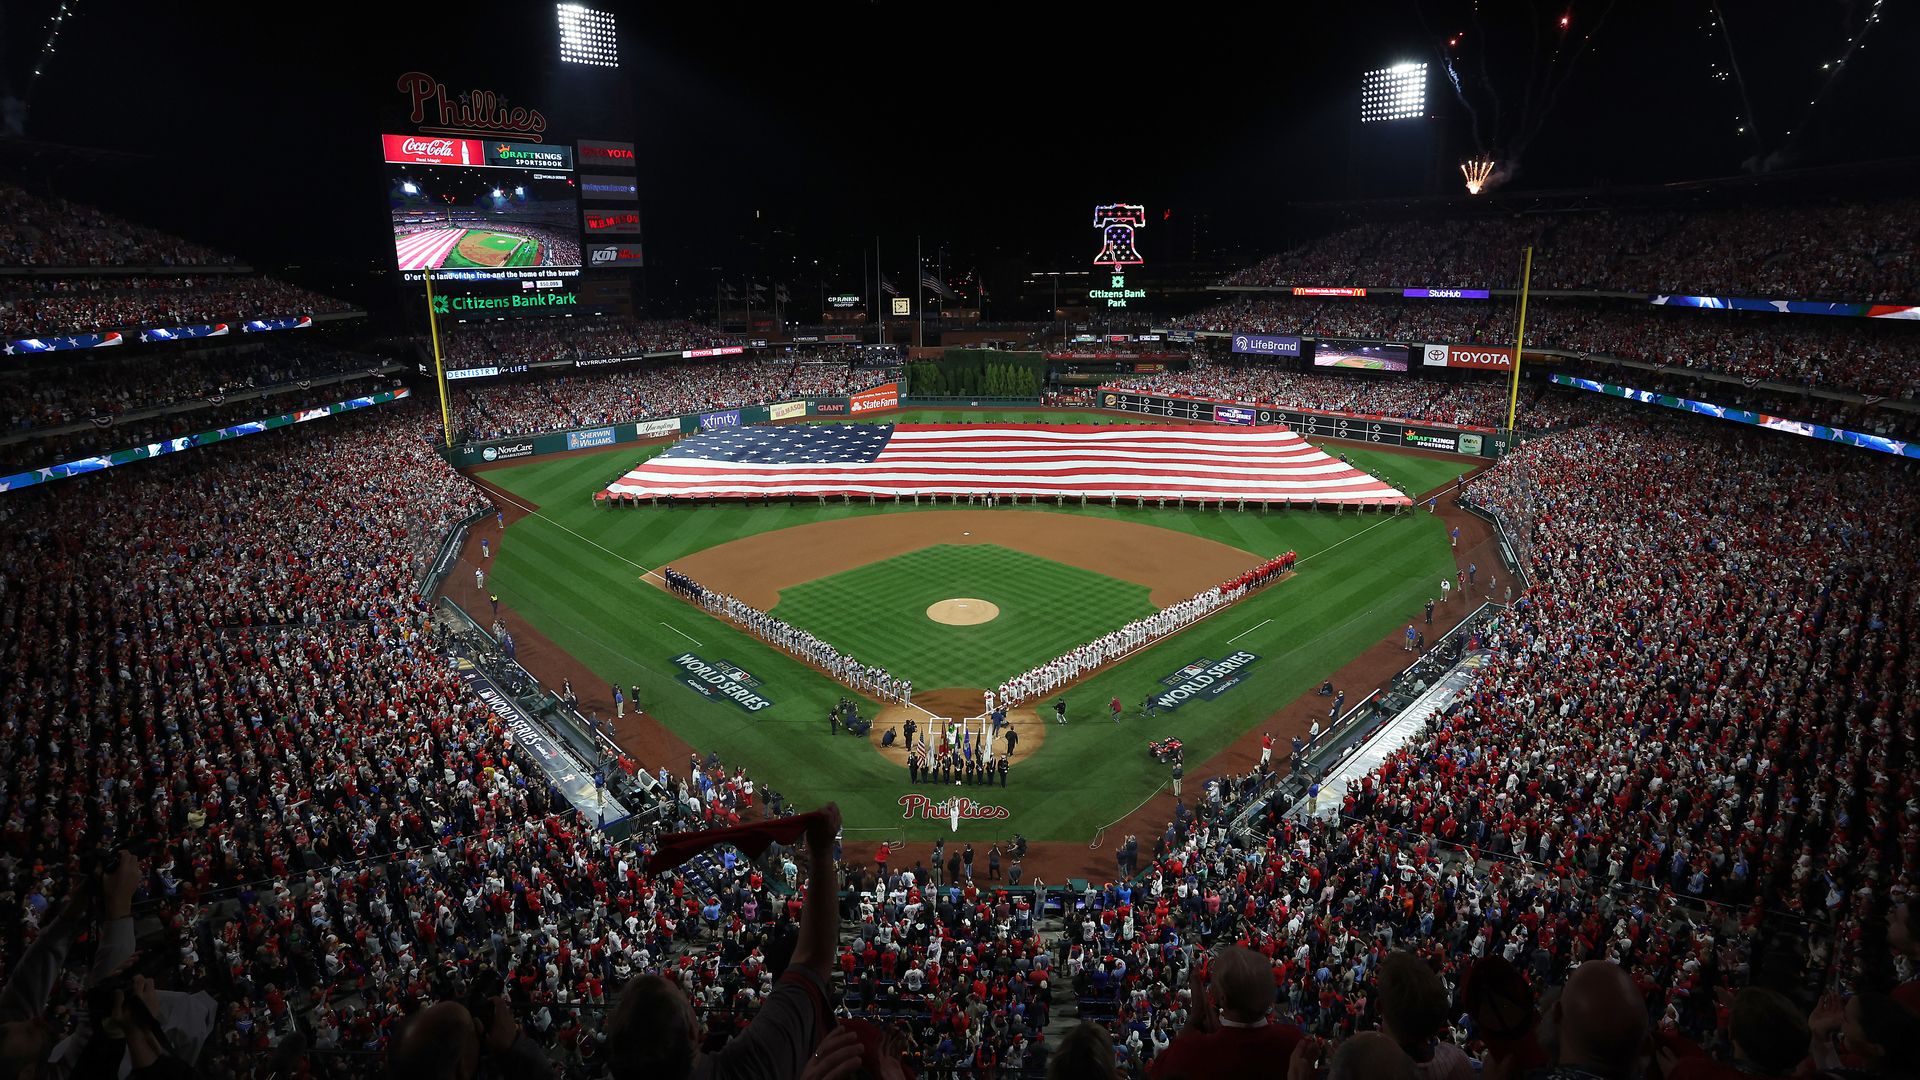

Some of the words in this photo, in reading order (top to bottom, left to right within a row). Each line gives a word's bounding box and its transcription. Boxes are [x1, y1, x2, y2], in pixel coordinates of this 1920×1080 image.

[397, 71, 546, 132] Phillies
[500, 151, 562, 160] DRAFTKINGS
[516, 159, 562, 167] SPORTSBOOK
[437, 272, 452, 280] land
[558, 269, 579, 277] brave?
[1089, 289, 1123, 298] Citizens
[1124, 289, 1146, 298] Bank
[1428, 289, 1461, 298] StubHub
[452, 297, 509, 310] Citizens
[512, 293, 546, 307] Bank
[548, 292, 577, 306] Park
[1108, 299, 1126, 307] Park
[1251, 340, 1297, 351] LifeBrand
[1452, 351, 1510, 365] TOYOTA
[448, 368, 496, 378] DENTISTRY
[510, 365, 528, 373] LIFE
[703, 413, 738, 428] xfinity
[580, 429, 611, 440] SHERWIN
[1407, 435, 1455, 445] DRAFTKINGS
[497, 443, 533, 454] NovaCare
[1417, 441, 1454, 450] SPORTSBOOK
[676, 654, 726, 683] WORLD
[717, 681, 770, 711] SERIES
[1158, 675, 1215, 708] WORLD
[1206, 651, 1256, 678] SERIES
[486, 695, 518, 722] WORLD
[508, 720, 542, 745] SERIES
